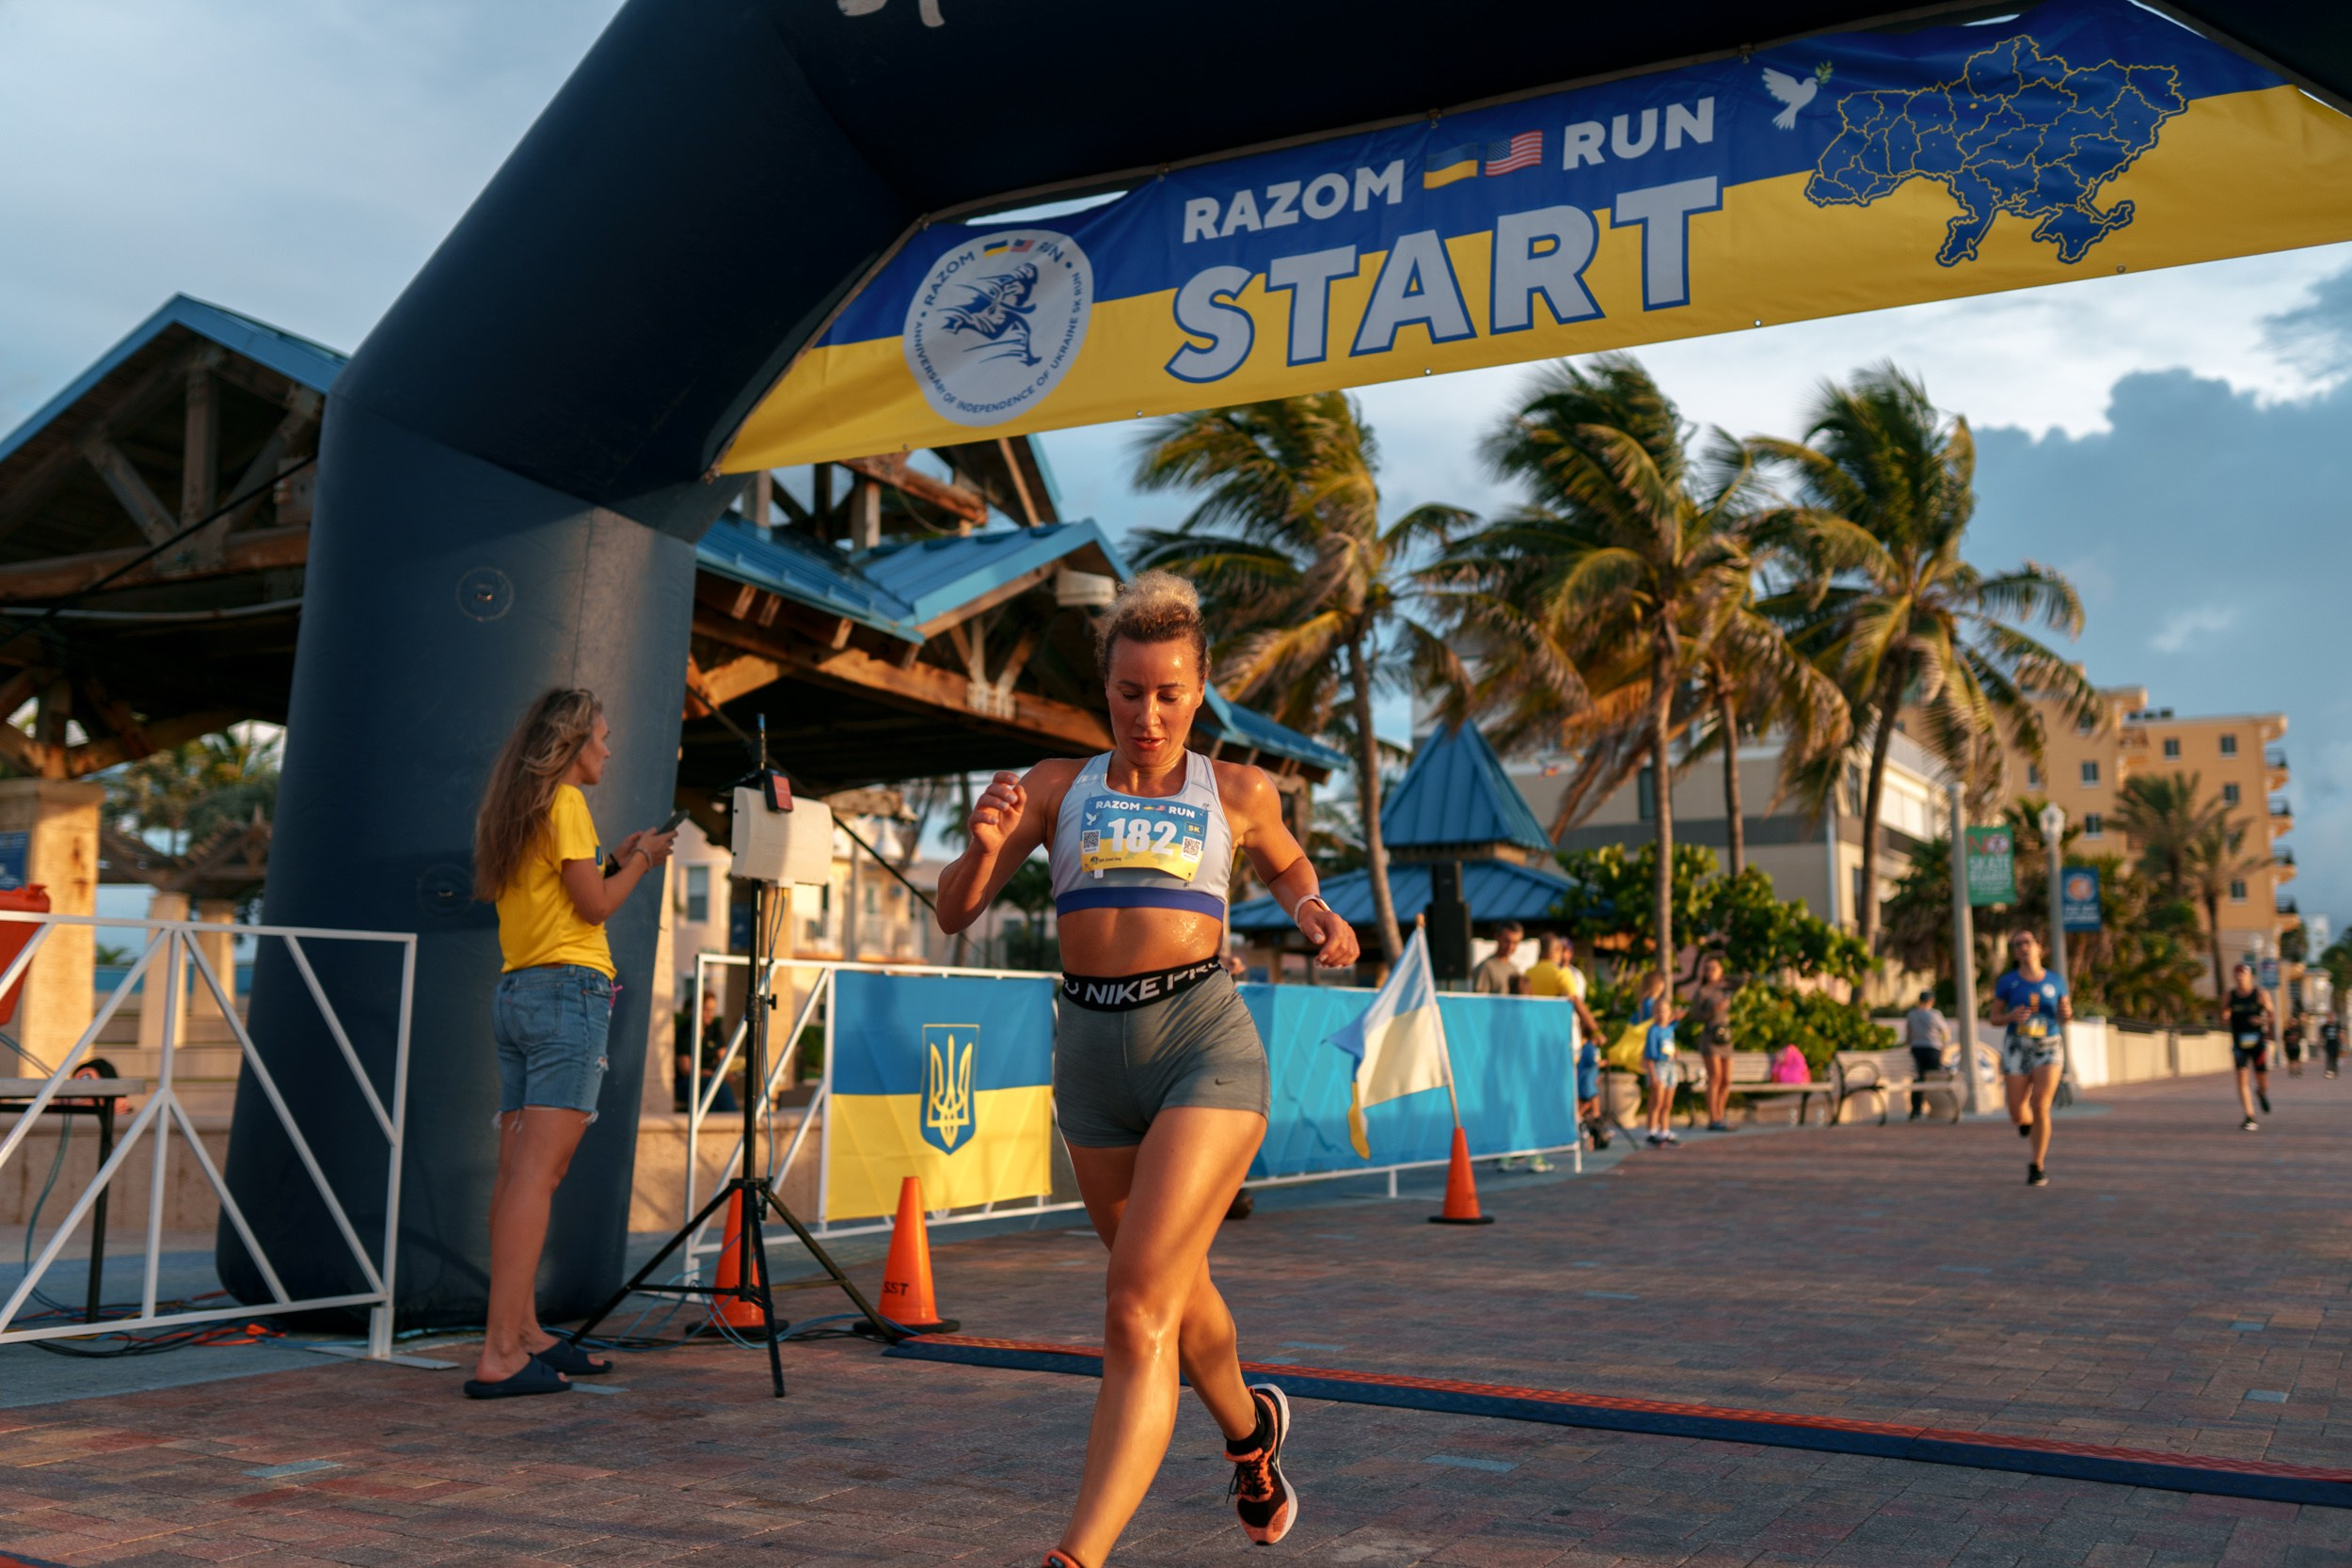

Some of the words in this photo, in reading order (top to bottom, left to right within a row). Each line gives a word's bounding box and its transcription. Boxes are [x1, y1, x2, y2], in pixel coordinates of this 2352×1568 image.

[1183, 159, 1405, 244] RAZOM
[1563, 97, 1715, 171] RUN
[924, 250, 976, 306] RAZOM
[1036, 241, 1065, 263] RUN
[1165, 175, 1723, 384] START
[945, 393, 958, 405] OF
[957, 388, 1035, 414] INDEPENDENCE
[1036, 372, 1050, 387] OF
[1049, 317, 1079, 370] UKRAINE
[1072, 272, 1082, 296] RUN
[1095, 800, 1140, 812] RAZOM
[1168, 805, 1196, 818] RUN
[1107, 817, 1178, 855] 182
[1188, 824, 1200, 833] 5K
[1085, 975, 1162, 1006] NIKE
[882, 1280, 909, 1296] SST
